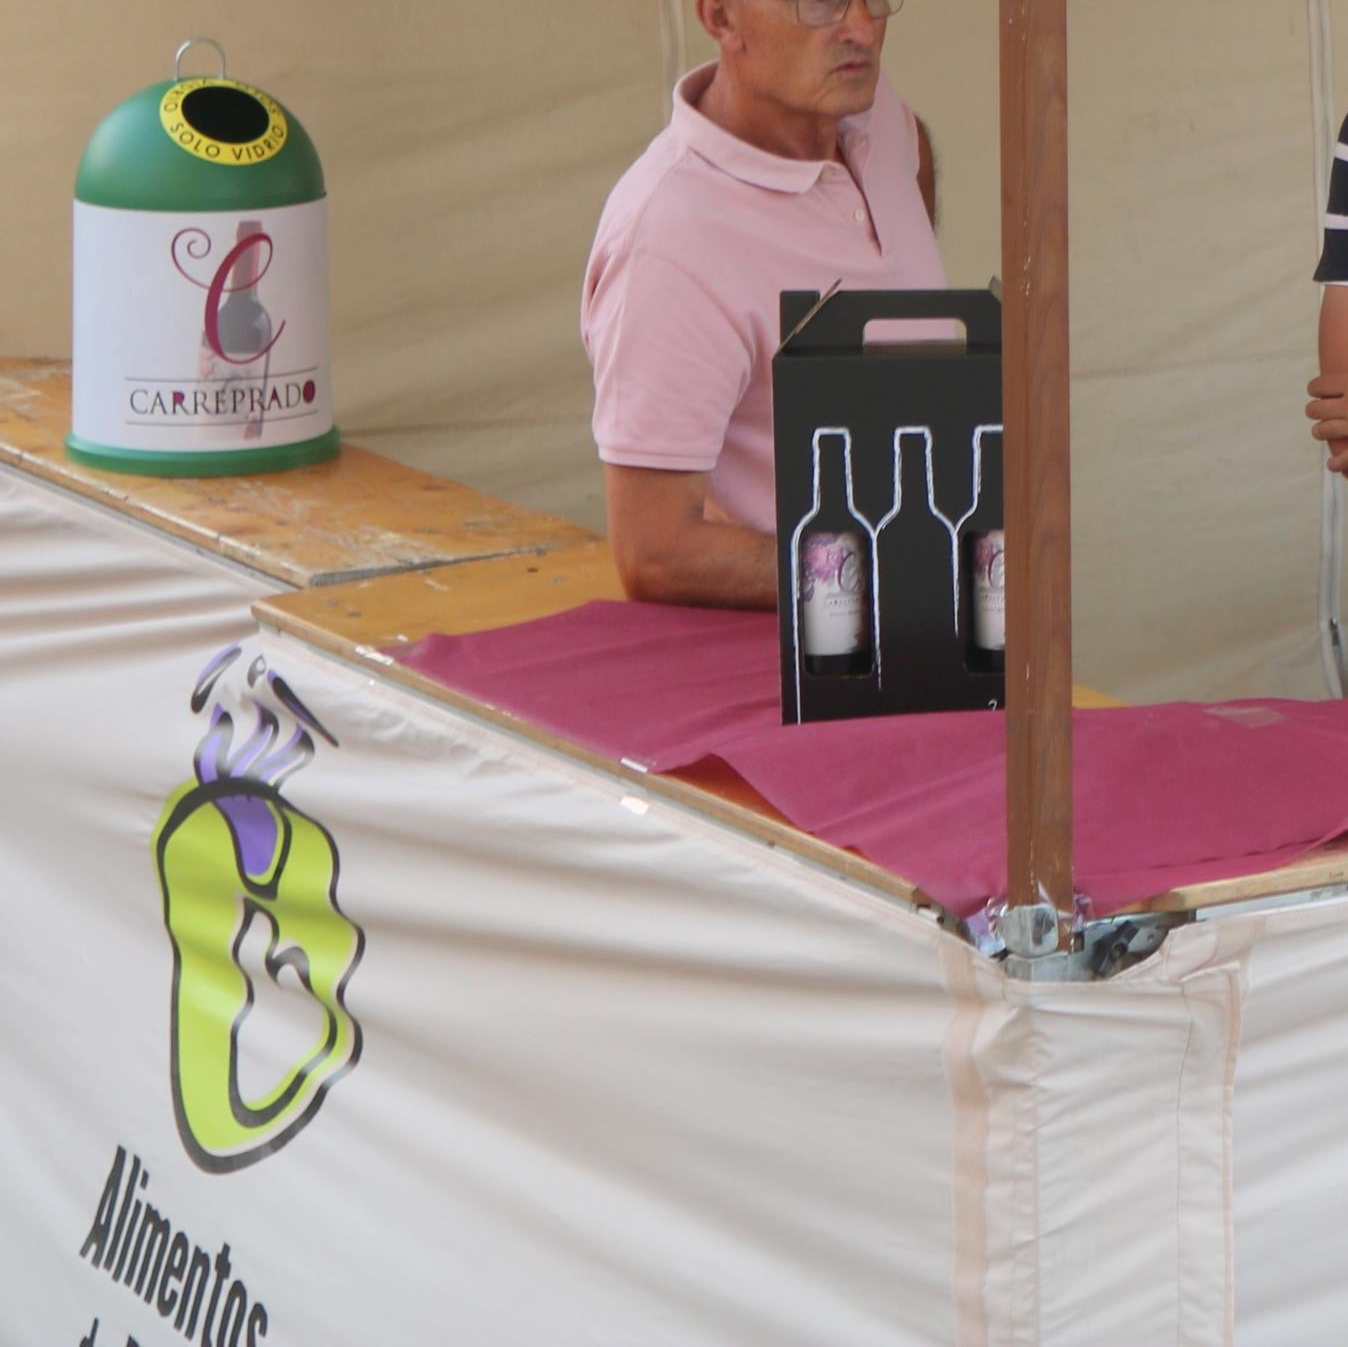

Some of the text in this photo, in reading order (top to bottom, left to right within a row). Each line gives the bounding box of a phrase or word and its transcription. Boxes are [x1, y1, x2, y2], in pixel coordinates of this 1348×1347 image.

[170, 122, 284, 162] SOLO VIDRIO
[130, 380, 316, 416] CARREPRADO
[80, 1145, 268, 1347] Alimentos
